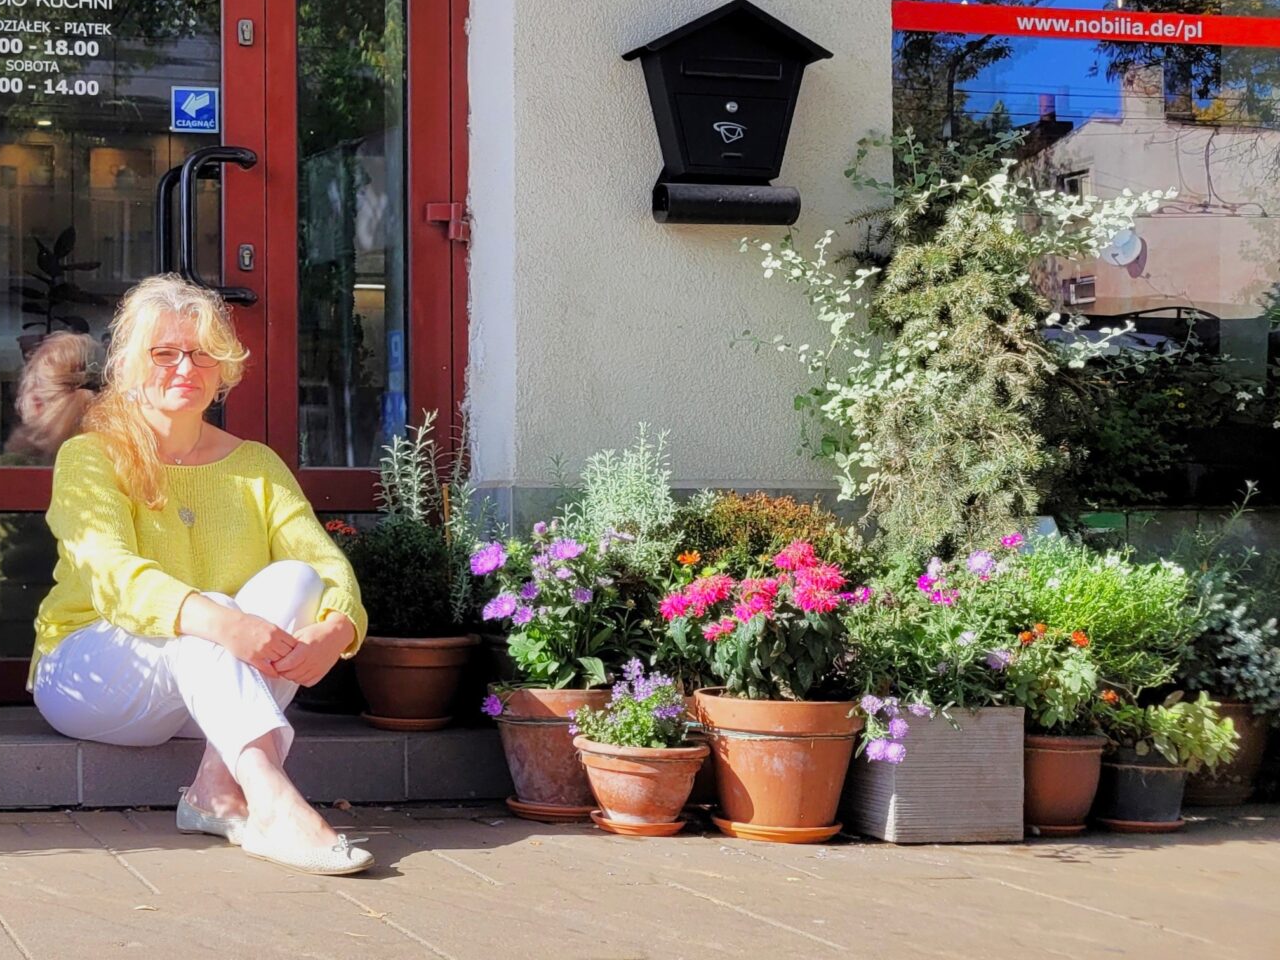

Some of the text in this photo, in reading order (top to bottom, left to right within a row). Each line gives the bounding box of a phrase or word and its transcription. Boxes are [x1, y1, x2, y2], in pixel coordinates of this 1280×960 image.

[64, 21, 112, 37] PIĄTEK
[1015, 16, 1203, 42] www.nobilia.de/pl
[43, 39, 100, 57] 18.00
[5, 59, 60, 73] SOBOTA
[43, 78, 100, 96] 14.00
[175, 118, 216, 129] CIĄGNĄĆ
